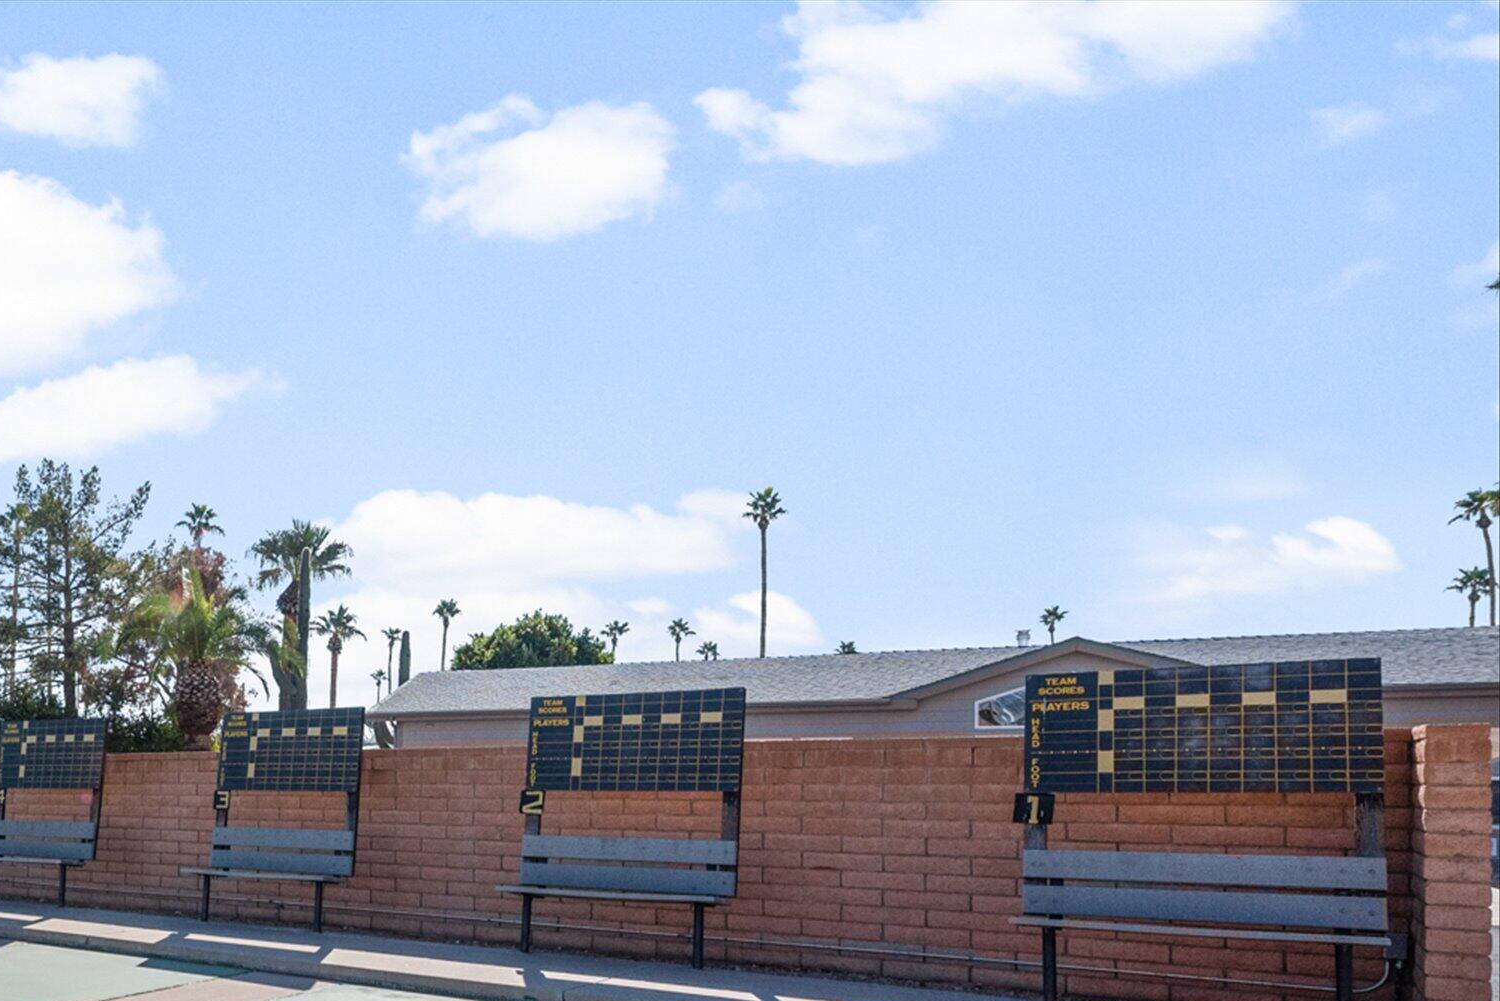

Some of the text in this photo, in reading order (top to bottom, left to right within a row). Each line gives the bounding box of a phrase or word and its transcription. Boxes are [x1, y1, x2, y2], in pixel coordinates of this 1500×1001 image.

[1045, 677, 1077, 687] TEAM
[1038, 686, 1085, 696] SCORES
[543, 699, 564, 707] TEAM
[1032, 701, 1090, 713] PLAYERS
[533, 718, 570, 727] PLAYERS
[1031, 717, 1041, 748] HEAD
[1030, 757, 1040, 789] FOOT
[215, 790, 230, 809] 3
[521, 790, 544, 815] 2
[1027, 795, 1040, 824] 1
